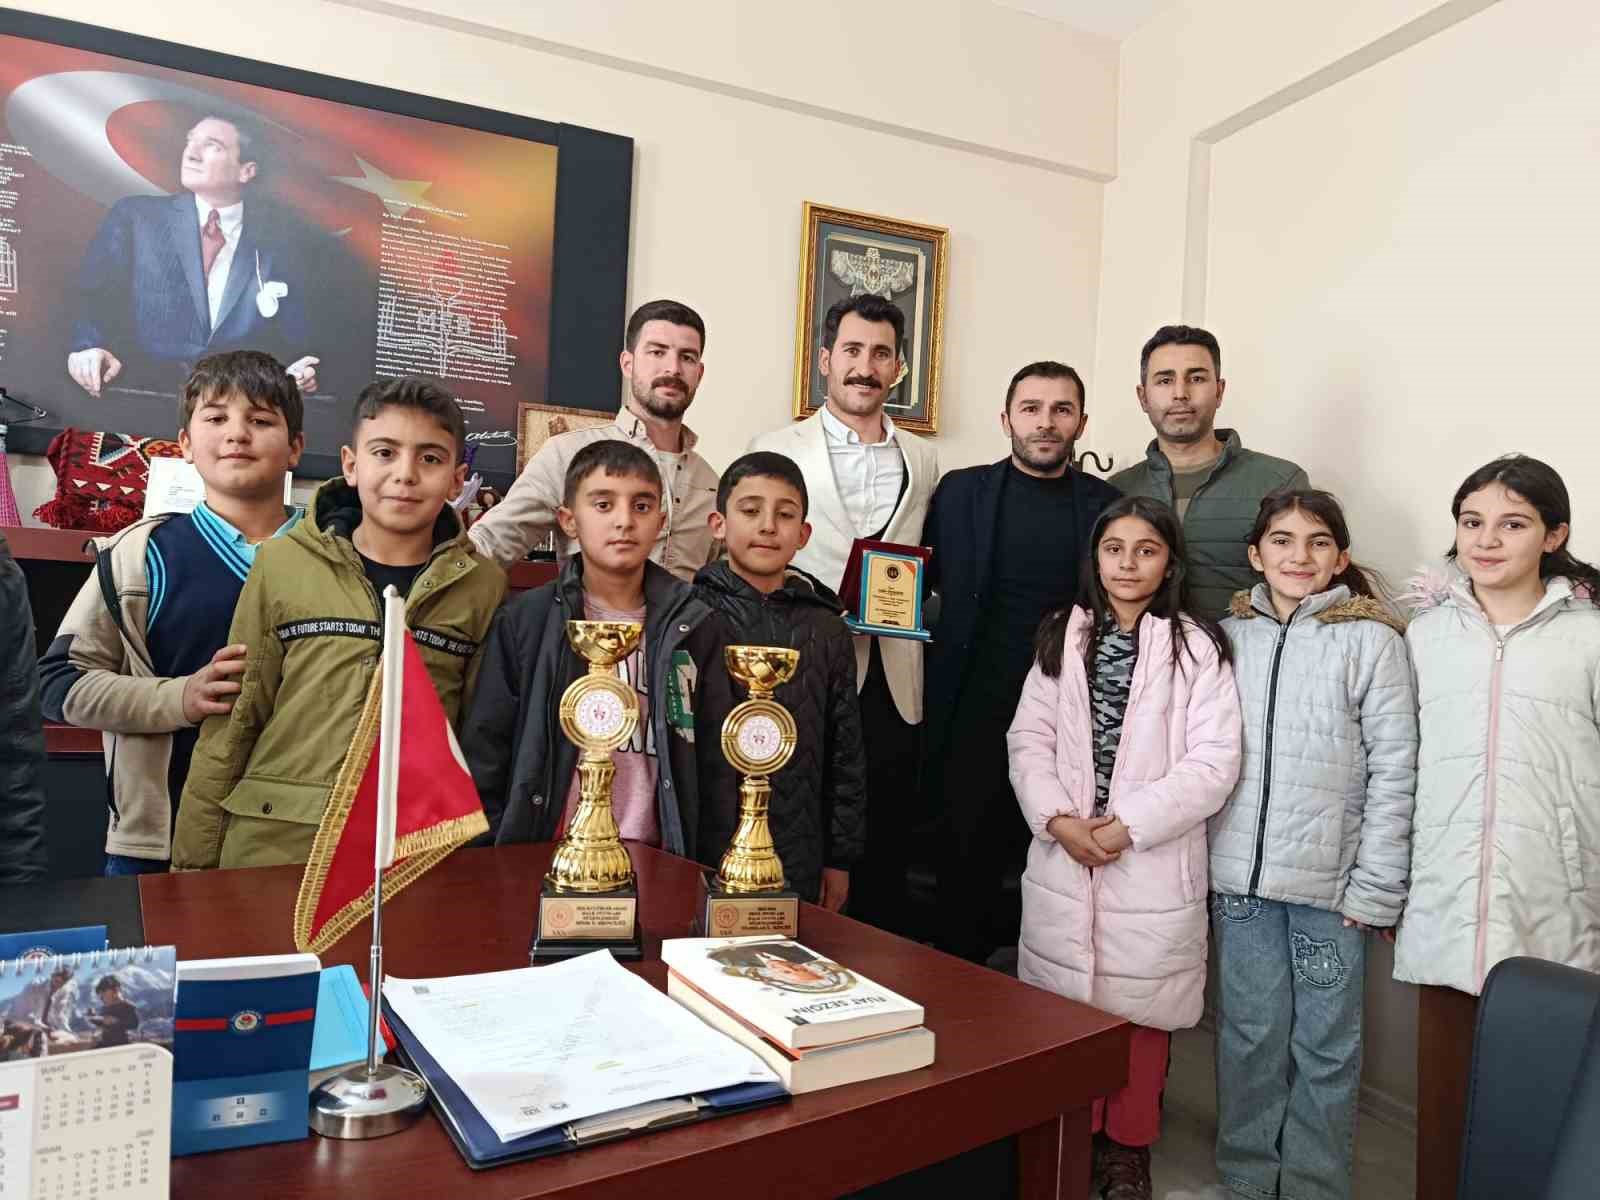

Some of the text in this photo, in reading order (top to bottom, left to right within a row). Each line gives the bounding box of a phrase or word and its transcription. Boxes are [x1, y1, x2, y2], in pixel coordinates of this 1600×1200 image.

[297, 622, 319, 634] FUTURE
[319, 621, 344, 632] STARTS
[345, 622, 366, 634] TODAY
